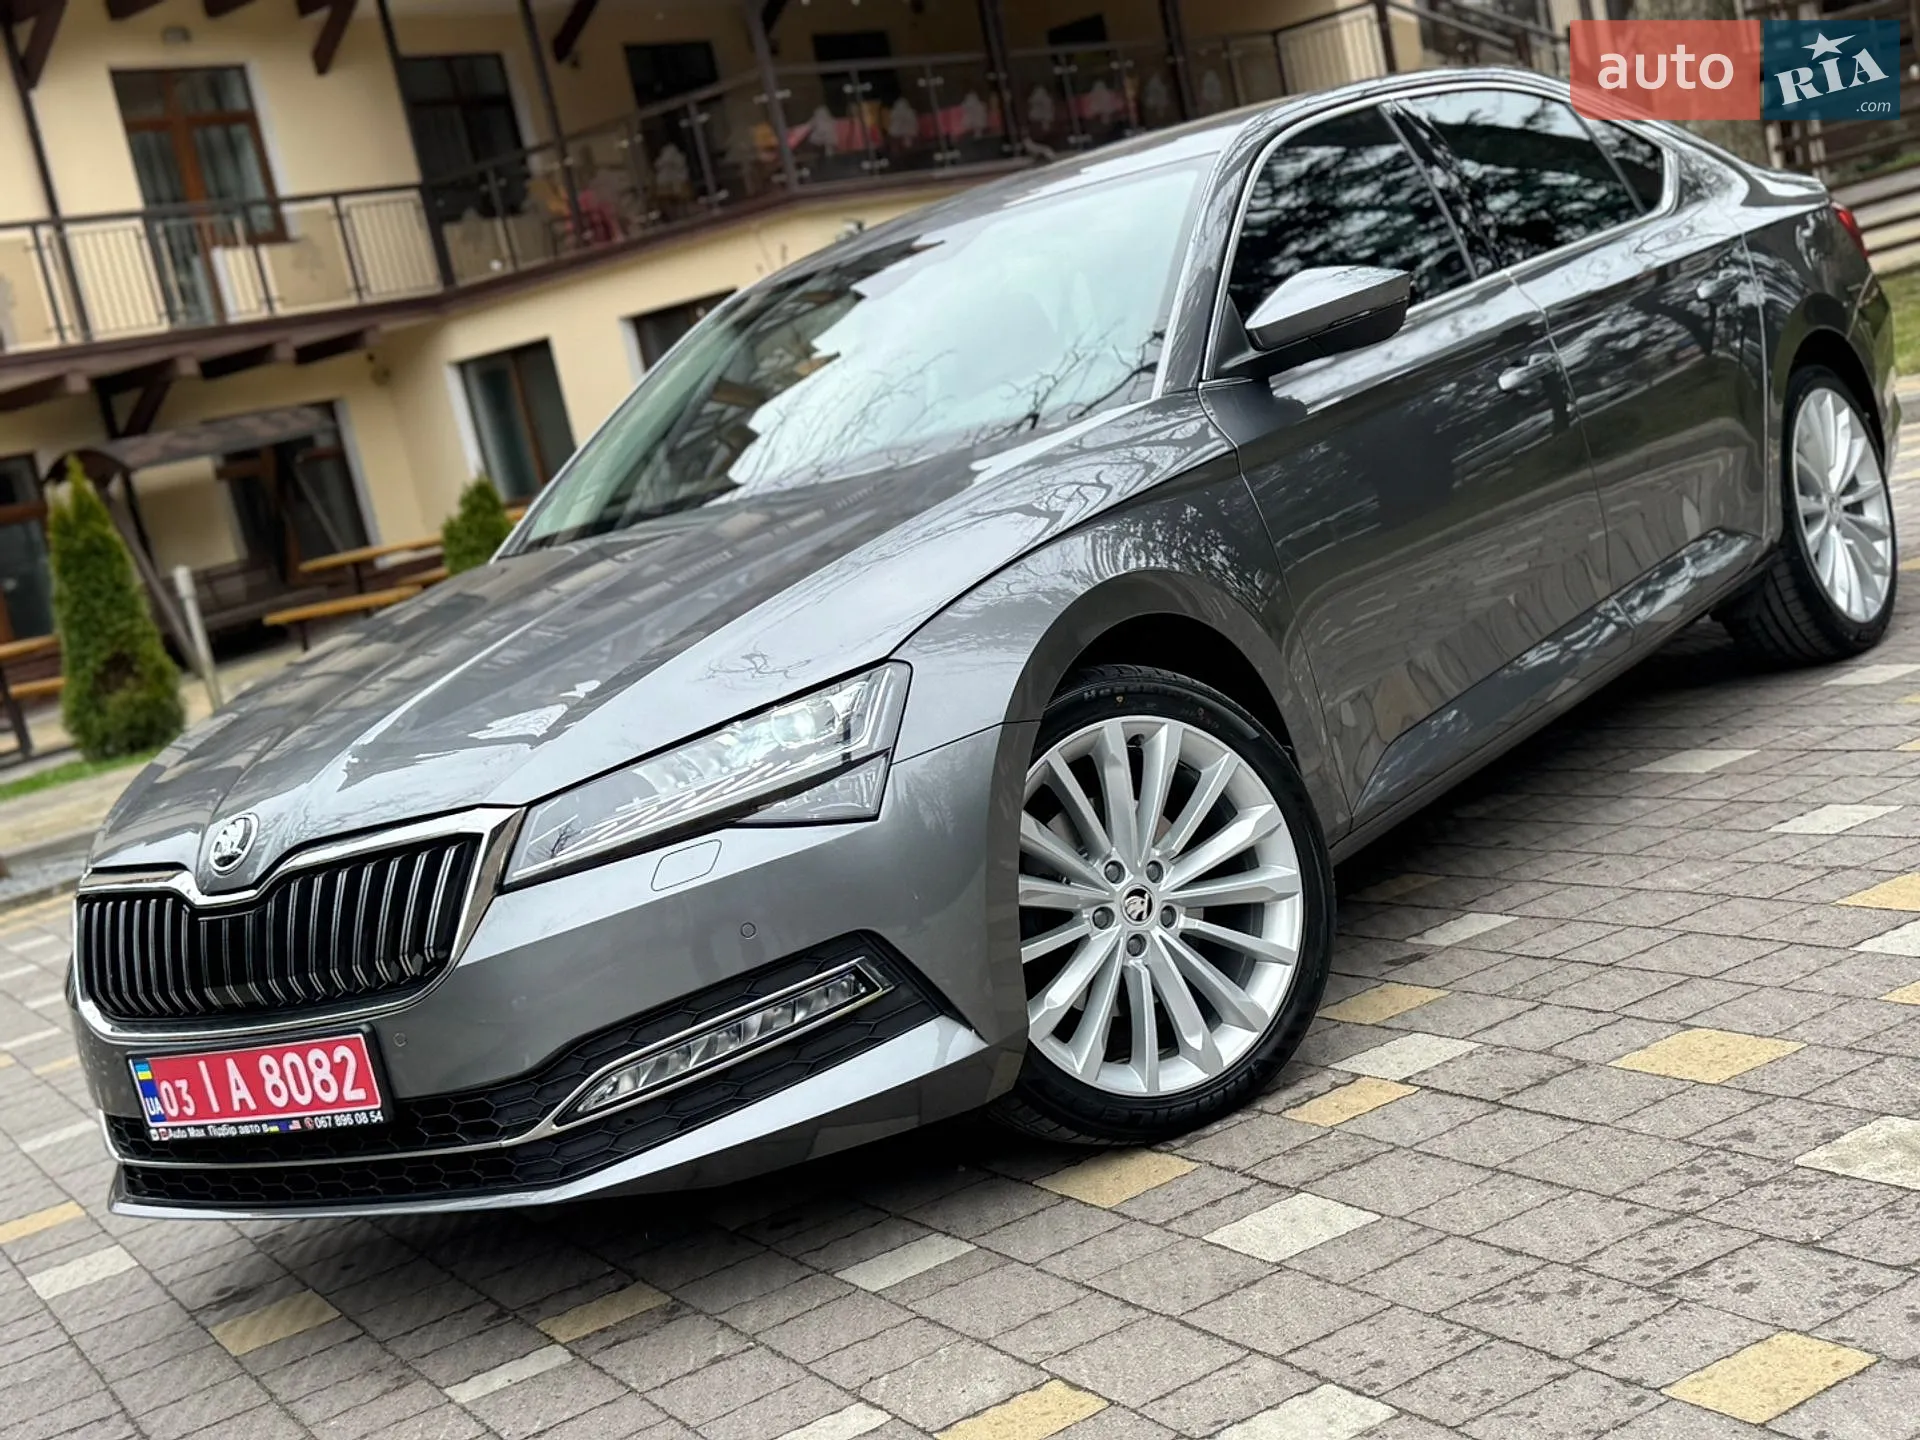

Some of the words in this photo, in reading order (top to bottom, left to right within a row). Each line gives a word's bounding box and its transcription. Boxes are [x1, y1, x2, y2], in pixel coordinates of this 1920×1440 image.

[160, 1079, 196, 1117] 03
[259, 1045, 366, 1108] 8082
[145, 1096, 165, 1116] UA
[314, 1115, 331, 1129] 067
[354, 1111, 368, 1125] 08
[369, 1110, 384, 1123] 54
